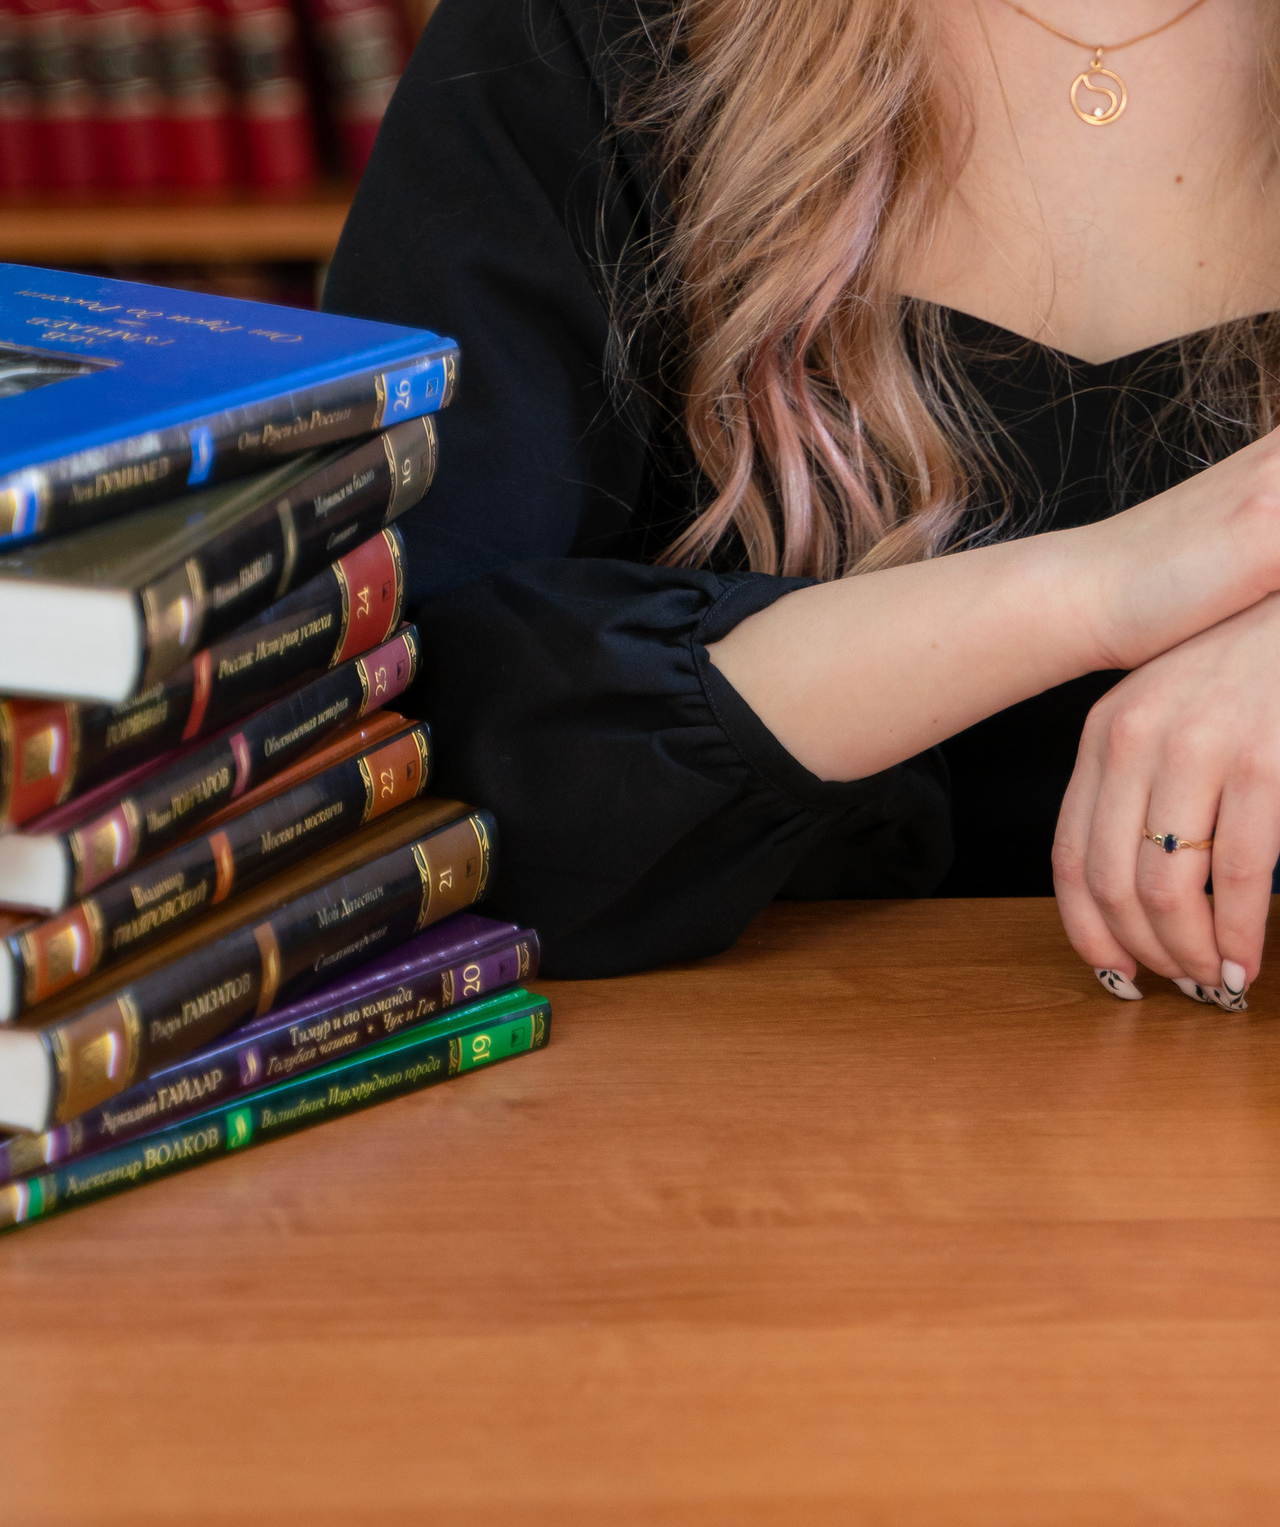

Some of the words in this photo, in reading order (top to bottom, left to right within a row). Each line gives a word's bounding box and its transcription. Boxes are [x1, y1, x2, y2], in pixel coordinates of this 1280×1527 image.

[394, 379, 411, 411] 26
[401, 458, 412, 486] 16
[357, 587, 369, 619] 24
[375, 667, 387, 696] 23
[381, 768, 395, 799] 22
[439, 869, 453, 893] 21
[463, 964, 481, 996] 20
[289, 1020, 332, 1047] Тимур
[343, 1009, 361, 1028] его
[362, 987, 413, 1018] команда
[267, 1045, 317, 1075] Голубая
[319, 1030, 358, 1055] чашка
[382, 1012, 405, 1033] Чук
[415, 1000, 436, 1019] Гек
[471, 1033, 492, 1063] 19
[157, 1069, 223, 1111] ГАЙДАР
[261, 1097, 325, 1129] Волшебник
[327, 1074, 402, 1107] Изумрудного
[403, 1055, 441, 1082] города
[144, 1126, 220, 1171] ВОЛКОВ
